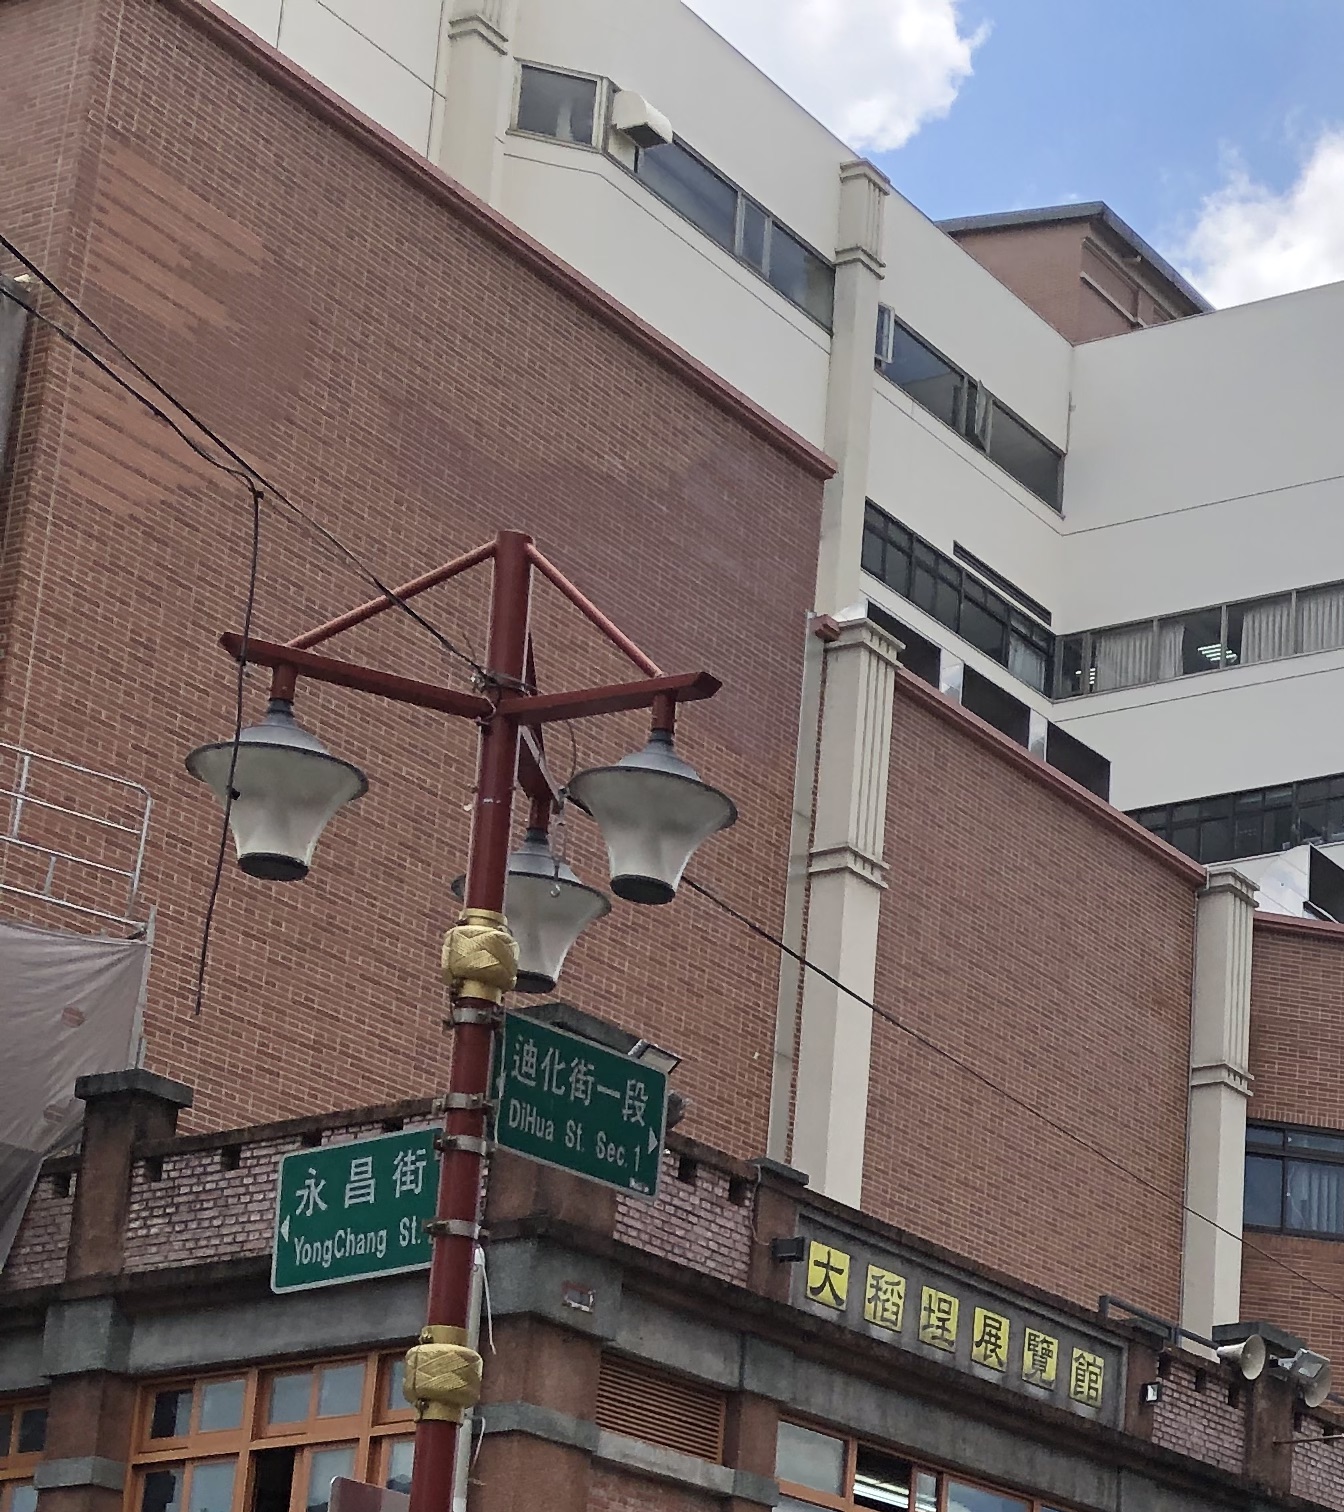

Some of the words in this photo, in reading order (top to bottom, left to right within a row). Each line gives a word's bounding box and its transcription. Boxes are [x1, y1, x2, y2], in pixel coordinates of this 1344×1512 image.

[511, 1033, 649, 1128] 迪化街一段
[508, 1097, 555, 1142] DiHua
[564, 1119, 585, 1153] St.
[595, 1130, 629, 1168] Sec.
[634, 1144, 641, 1172] 1
[295, 1148, 428, 1217] 永昌街
[293, 1227, 388, 1268] YongChang
[399, 1215, 422, 1248] St.
[808, 1248, 1102, 1403] 大稻埕展覽館
